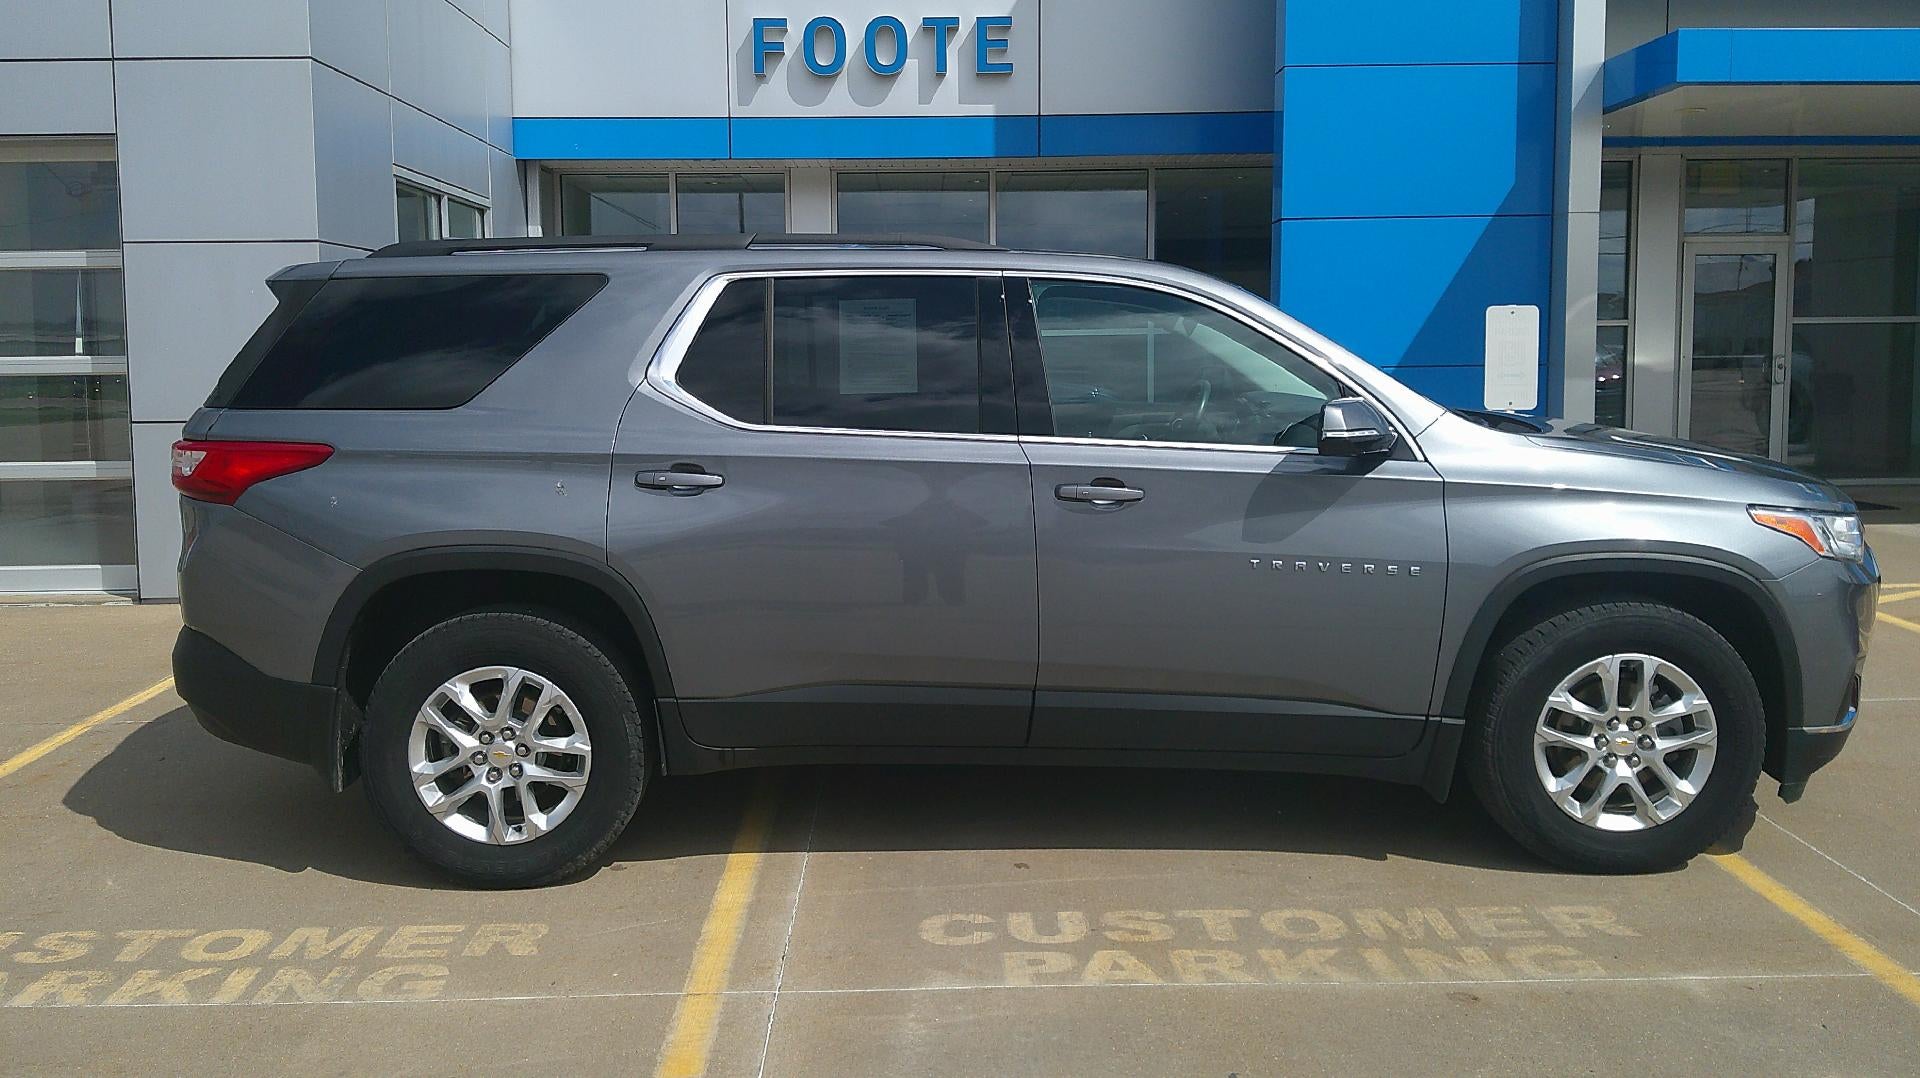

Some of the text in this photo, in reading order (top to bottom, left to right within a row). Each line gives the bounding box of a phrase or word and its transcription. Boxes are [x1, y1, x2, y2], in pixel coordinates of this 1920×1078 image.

[752, 15, 1014, 76] FOOTE
[1250, 559, 1422, 576] TRAVERSE
[918, 906, 1643, 946] CUSTOMER
[0, 964, 450, 1006] RKING
[1002, 946, 1607, 986] PARKING
